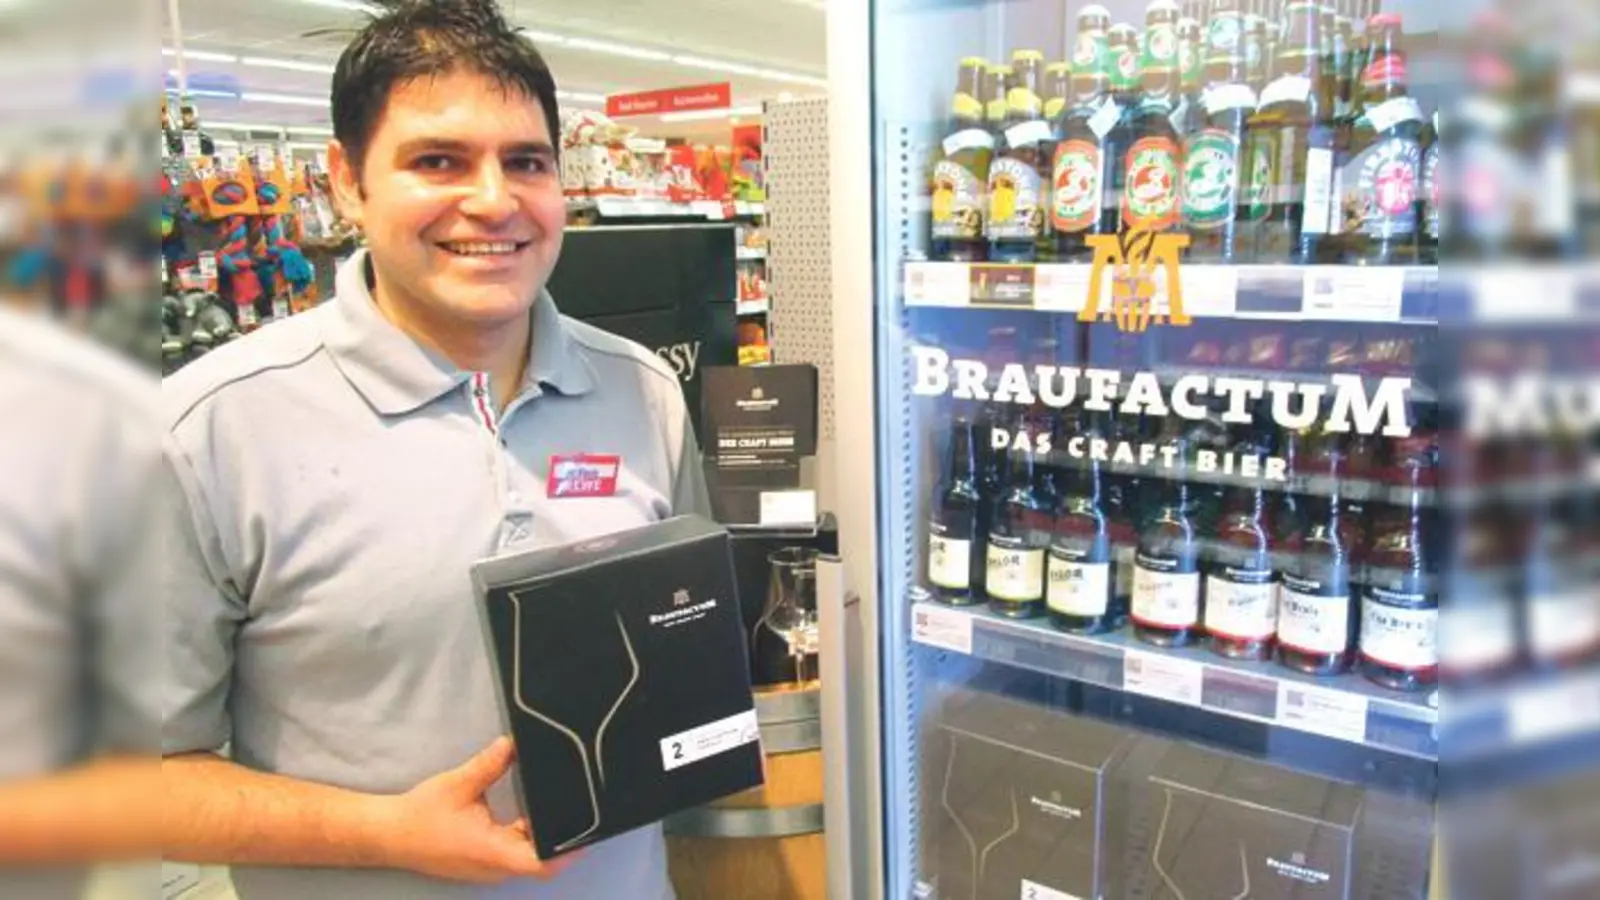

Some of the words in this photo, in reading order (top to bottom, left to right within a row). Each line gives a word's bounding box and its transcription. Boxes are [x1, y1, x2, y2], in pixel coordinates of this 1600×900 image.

[911, 345, 1412, 438] BRAUFACTUM
[991, 428, 1052, 455] DAS
[1068, 436, 1179, 469] CRAFT
[1197, 450, 1289, 482] BIER
[671, 741, 685, 760] 2
